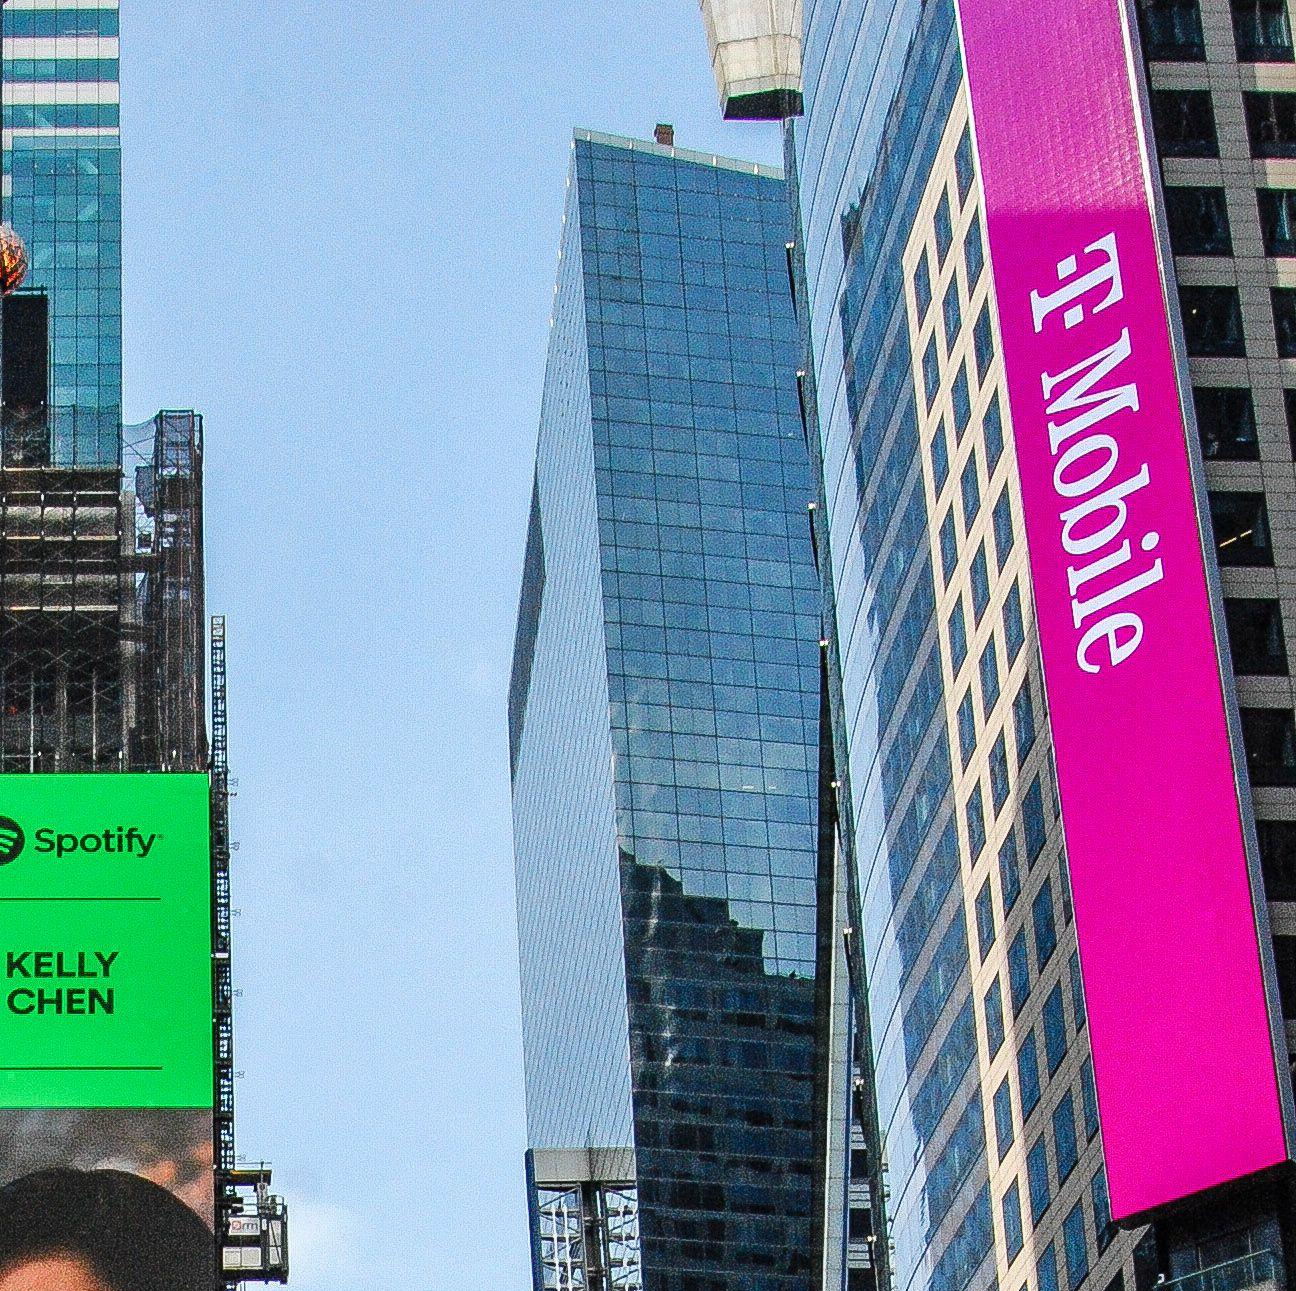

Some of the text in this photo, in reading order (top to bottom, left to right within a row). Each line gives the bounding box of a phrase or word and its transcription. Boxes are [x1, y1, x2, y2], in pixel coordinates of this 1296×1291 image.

[33, 826, 156, 858] Spotify
[6, 951, 118, 978] KELLY
[7, 987, 115, 1015] CHEN
